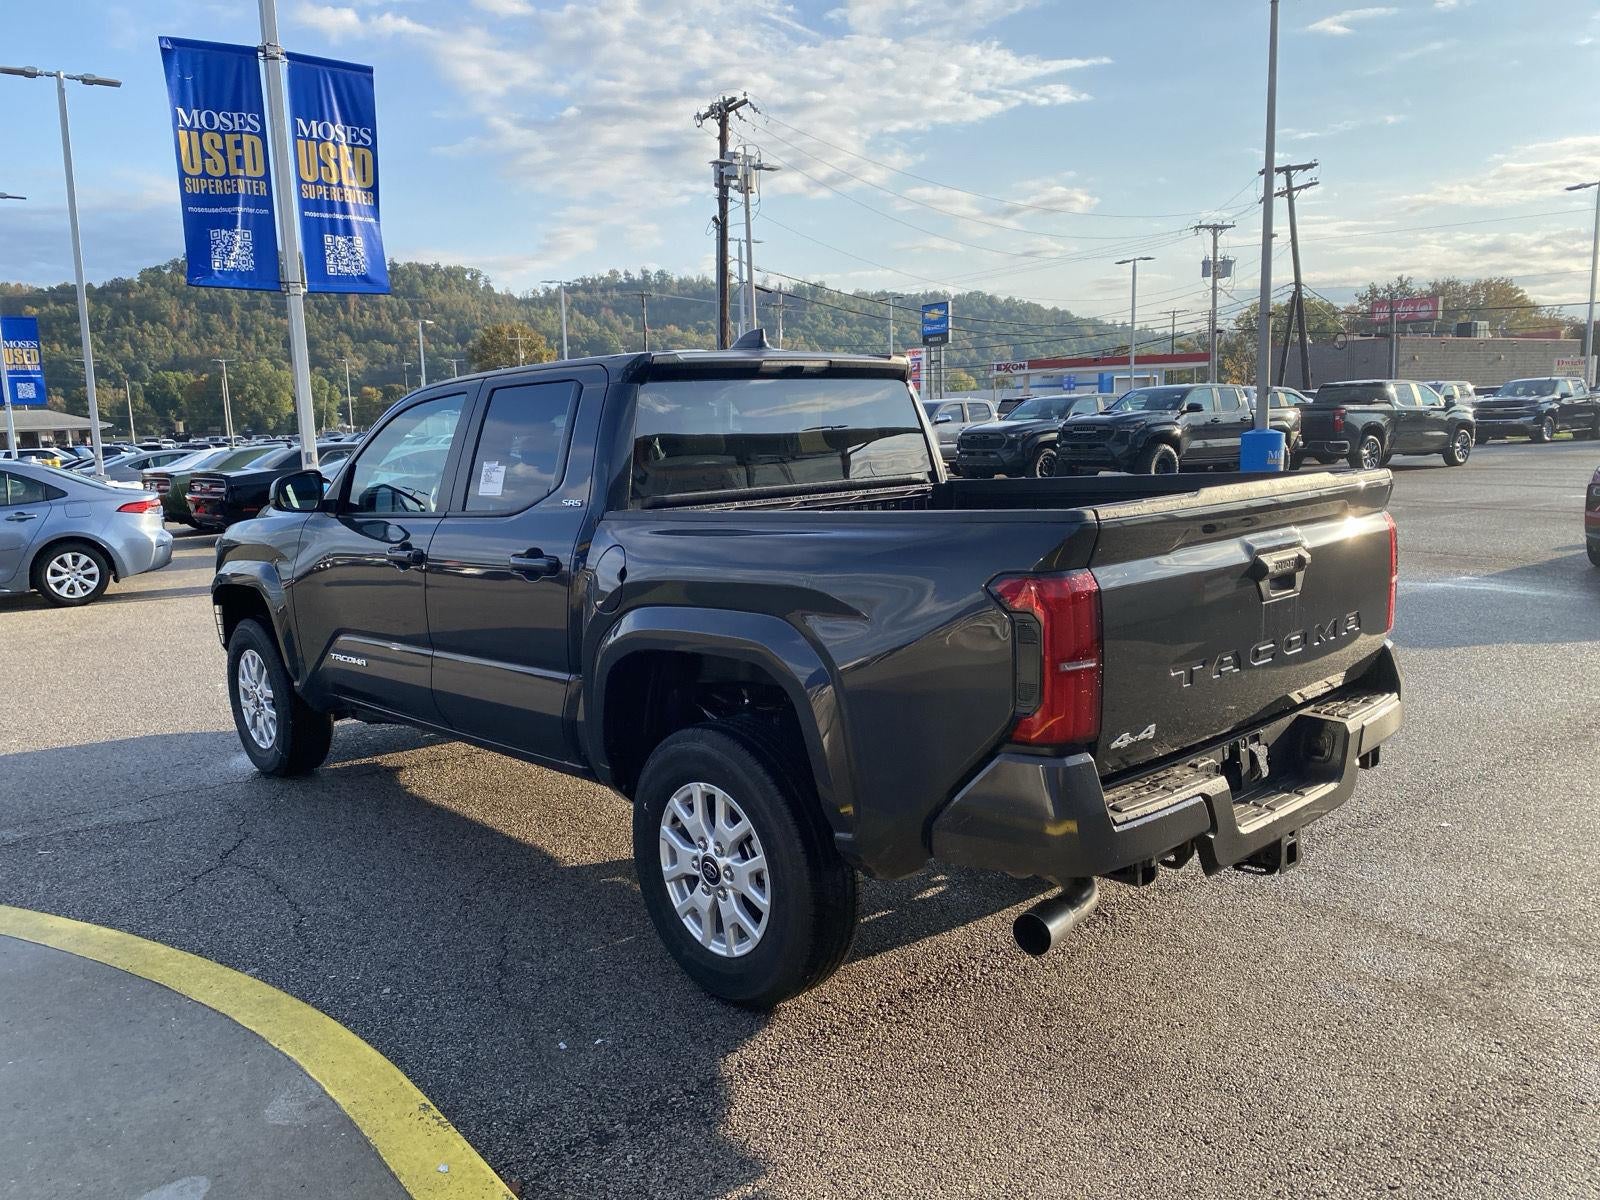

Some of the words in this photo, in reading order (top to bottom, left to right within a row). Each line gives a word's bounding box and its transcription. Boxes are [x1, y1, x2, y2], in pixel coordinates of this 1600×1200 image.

[175, 107, 261, 133] MOSES
[295, 117, 372, 146] MOSES
[178, 130, 265, 177] USED
[297, 139, 374, 188] USED
[185, 178, 268, 196] SUPERCENTER
[301, 184, 374, 206] SUPERCENTER
[188, 206, 269, 215] mosesusedsupercenter.com
[3, 340, 38, 348] MOSES
[4, 348, 40, 365] USED
[996, 362, 1026, 373] EXXON
[1170, 610, 1361, 688] TACOMA
[330, 652, 367, 667] TACOMA
